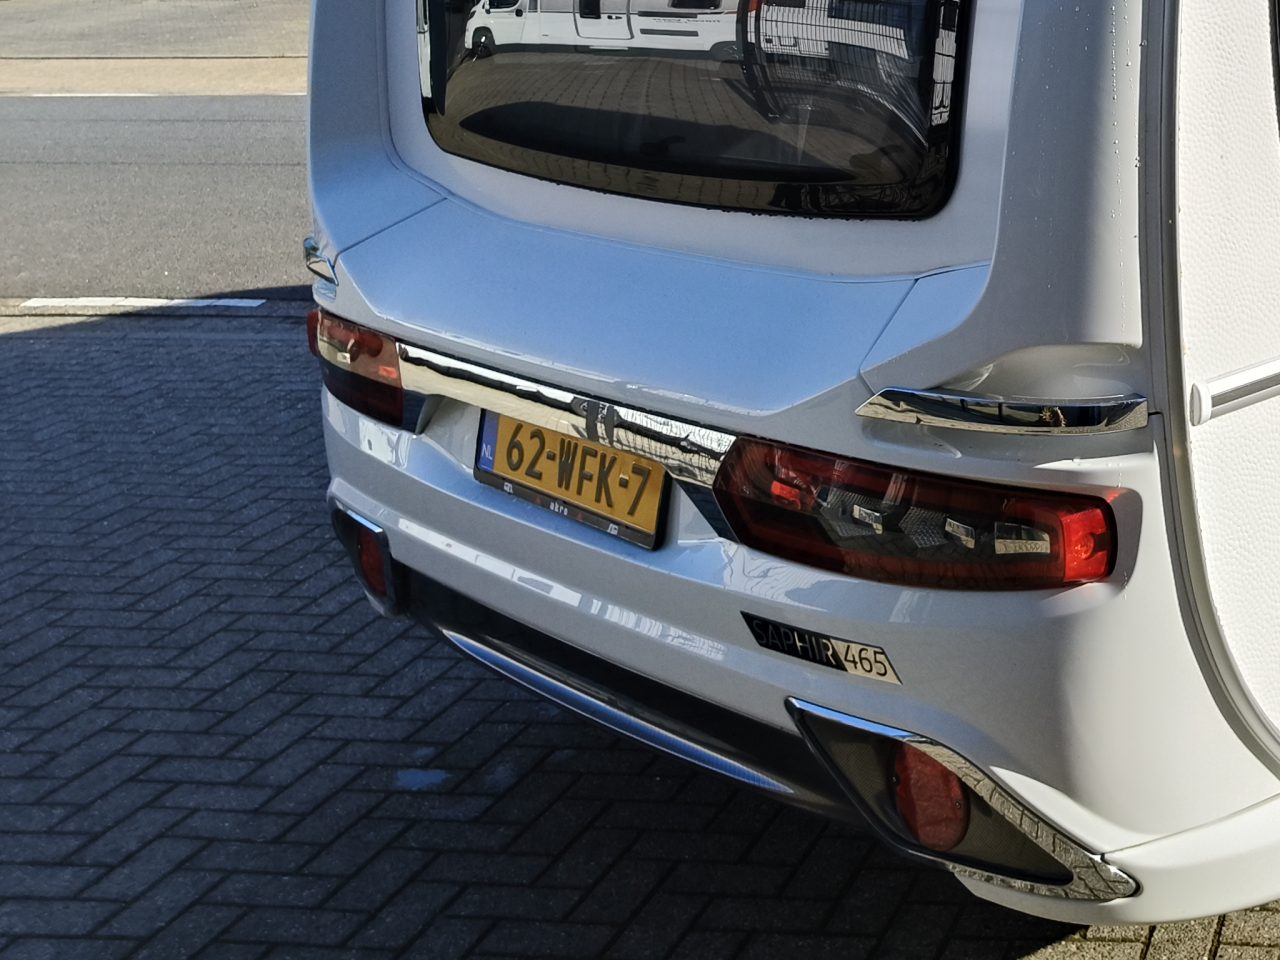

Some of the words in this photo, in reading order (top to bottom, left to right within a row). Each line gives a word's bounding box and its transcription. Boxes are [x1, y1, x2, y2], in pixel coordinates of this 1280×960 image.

[481, 442, 493, 461] NL
[505, 422, 652, 518] 62-WFK-7
[752, 619, 837, 666] SAPHIR
[843, 644, 888, 677] 465
